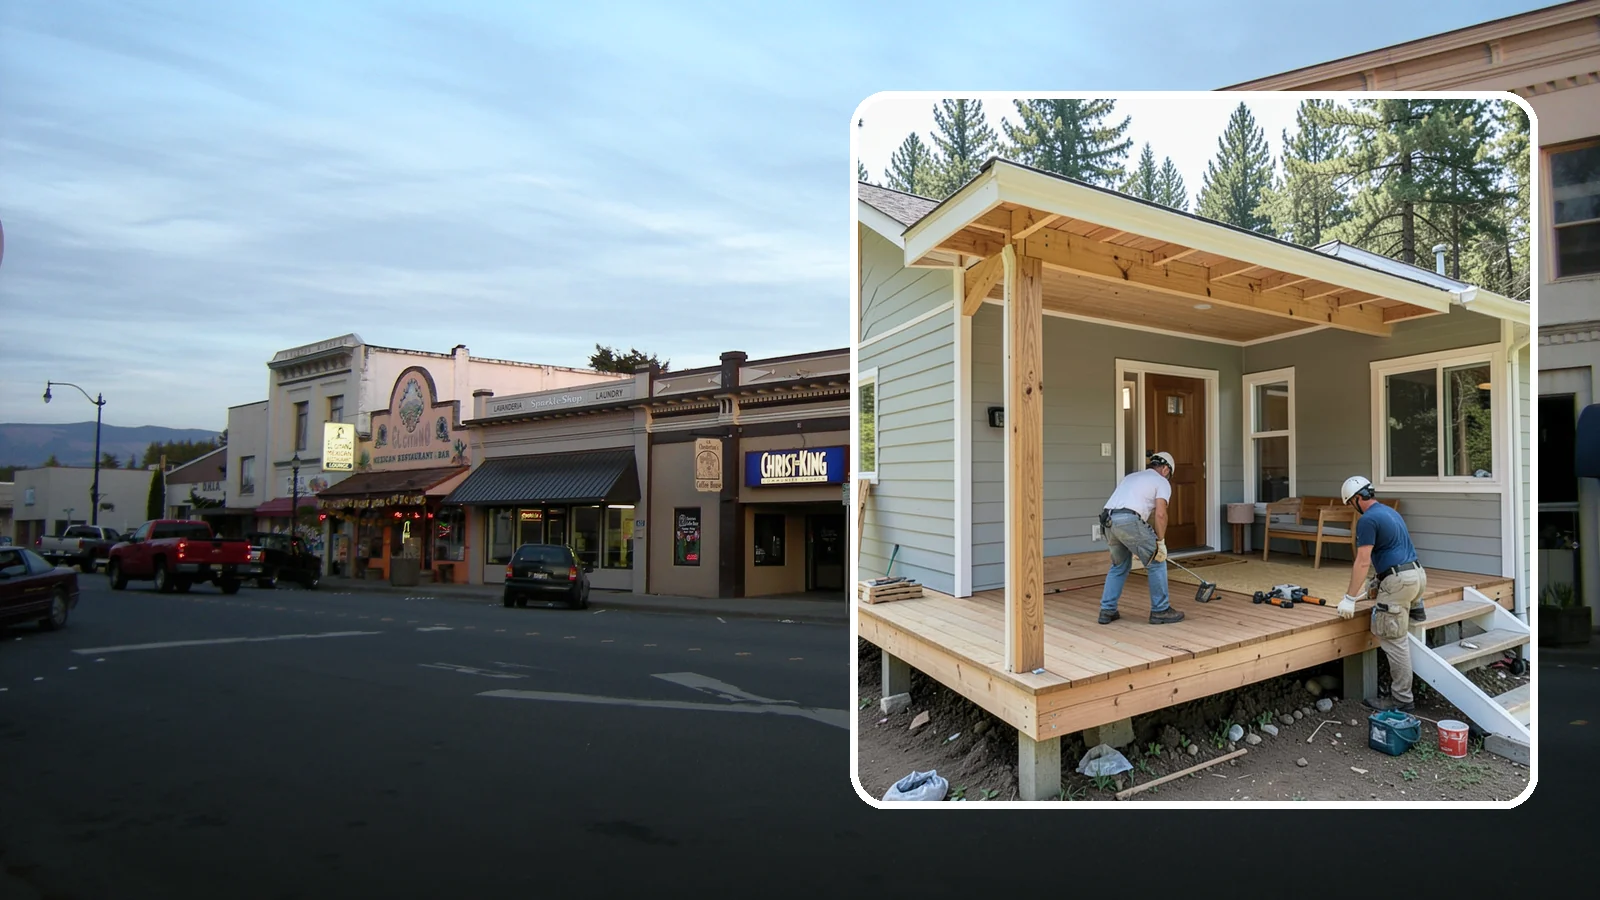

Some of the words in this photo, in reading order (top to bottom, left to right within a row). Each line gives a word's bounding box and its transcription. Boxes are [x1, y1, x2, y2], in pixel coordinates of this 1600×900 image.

[595, 389, 623, 400] LAUNDRY
[493, 402, 523, 412] LAVANDERIA
[374, 454, 396, 464] MEXICAN
[397, 451, 434, 462] RESTAURANT
[438, 450, 450, 459] BAR
[761, 452, 797, 478] CHRIST
[799, 450, 828, 477] KING
[696, 481, 709, 489] Coffee
